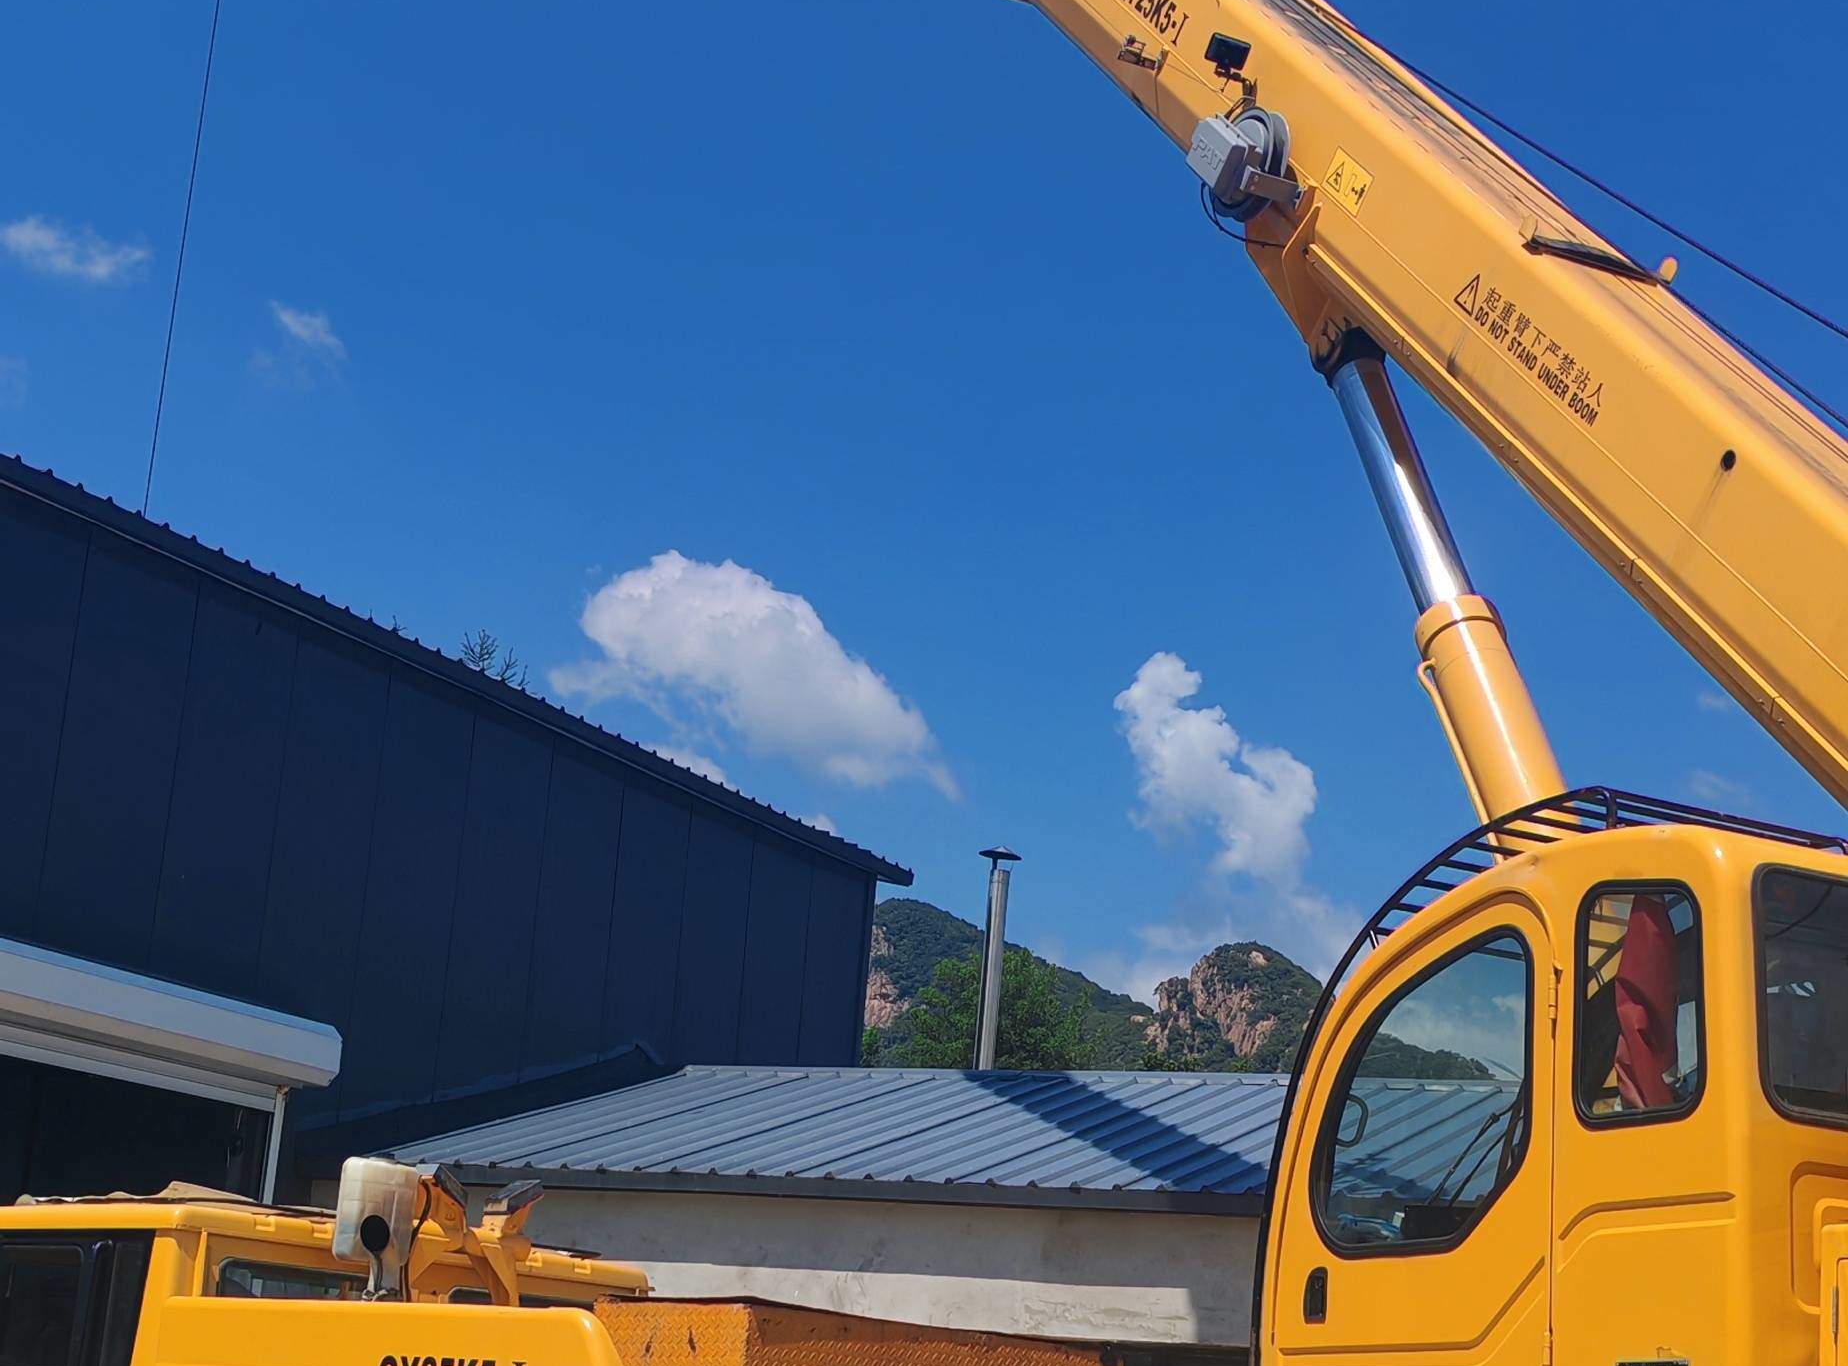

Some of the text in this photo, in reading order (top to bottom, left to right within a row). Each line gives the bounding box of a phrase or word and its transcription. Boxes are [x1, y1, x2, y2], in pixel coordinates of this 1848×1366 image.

[1474, 306, 1599, 427] DO NOT STAND UNDER BOOM
[1482, 287, 1604, 408] 起重臂下严禁站人
